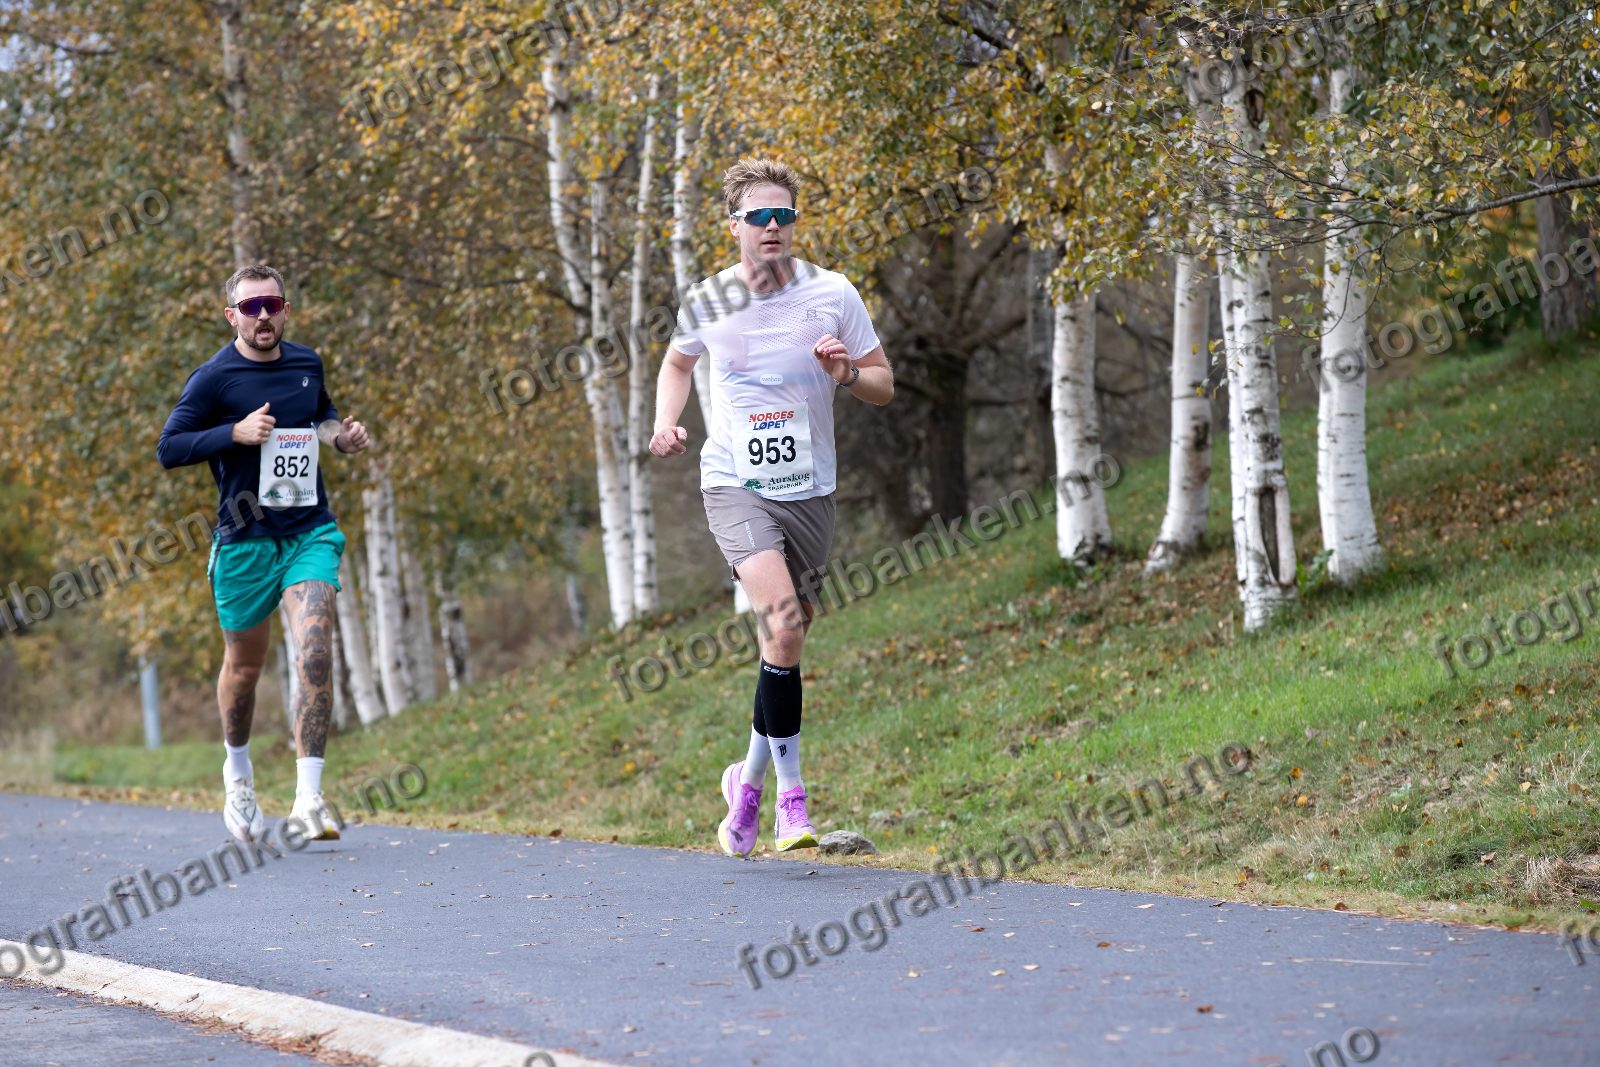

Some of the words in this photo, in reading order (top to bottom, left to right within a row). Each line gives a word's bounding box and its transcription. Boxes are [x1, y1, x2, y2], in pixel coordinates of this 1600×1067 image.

[749, 411, 794, 422] NORGES
[753, 420, 787, 430] LØPET
[748, 436, 796, 465] 953
[274, 455, 309, 478] 852
[768, 473, 811, 485] Aurskog
